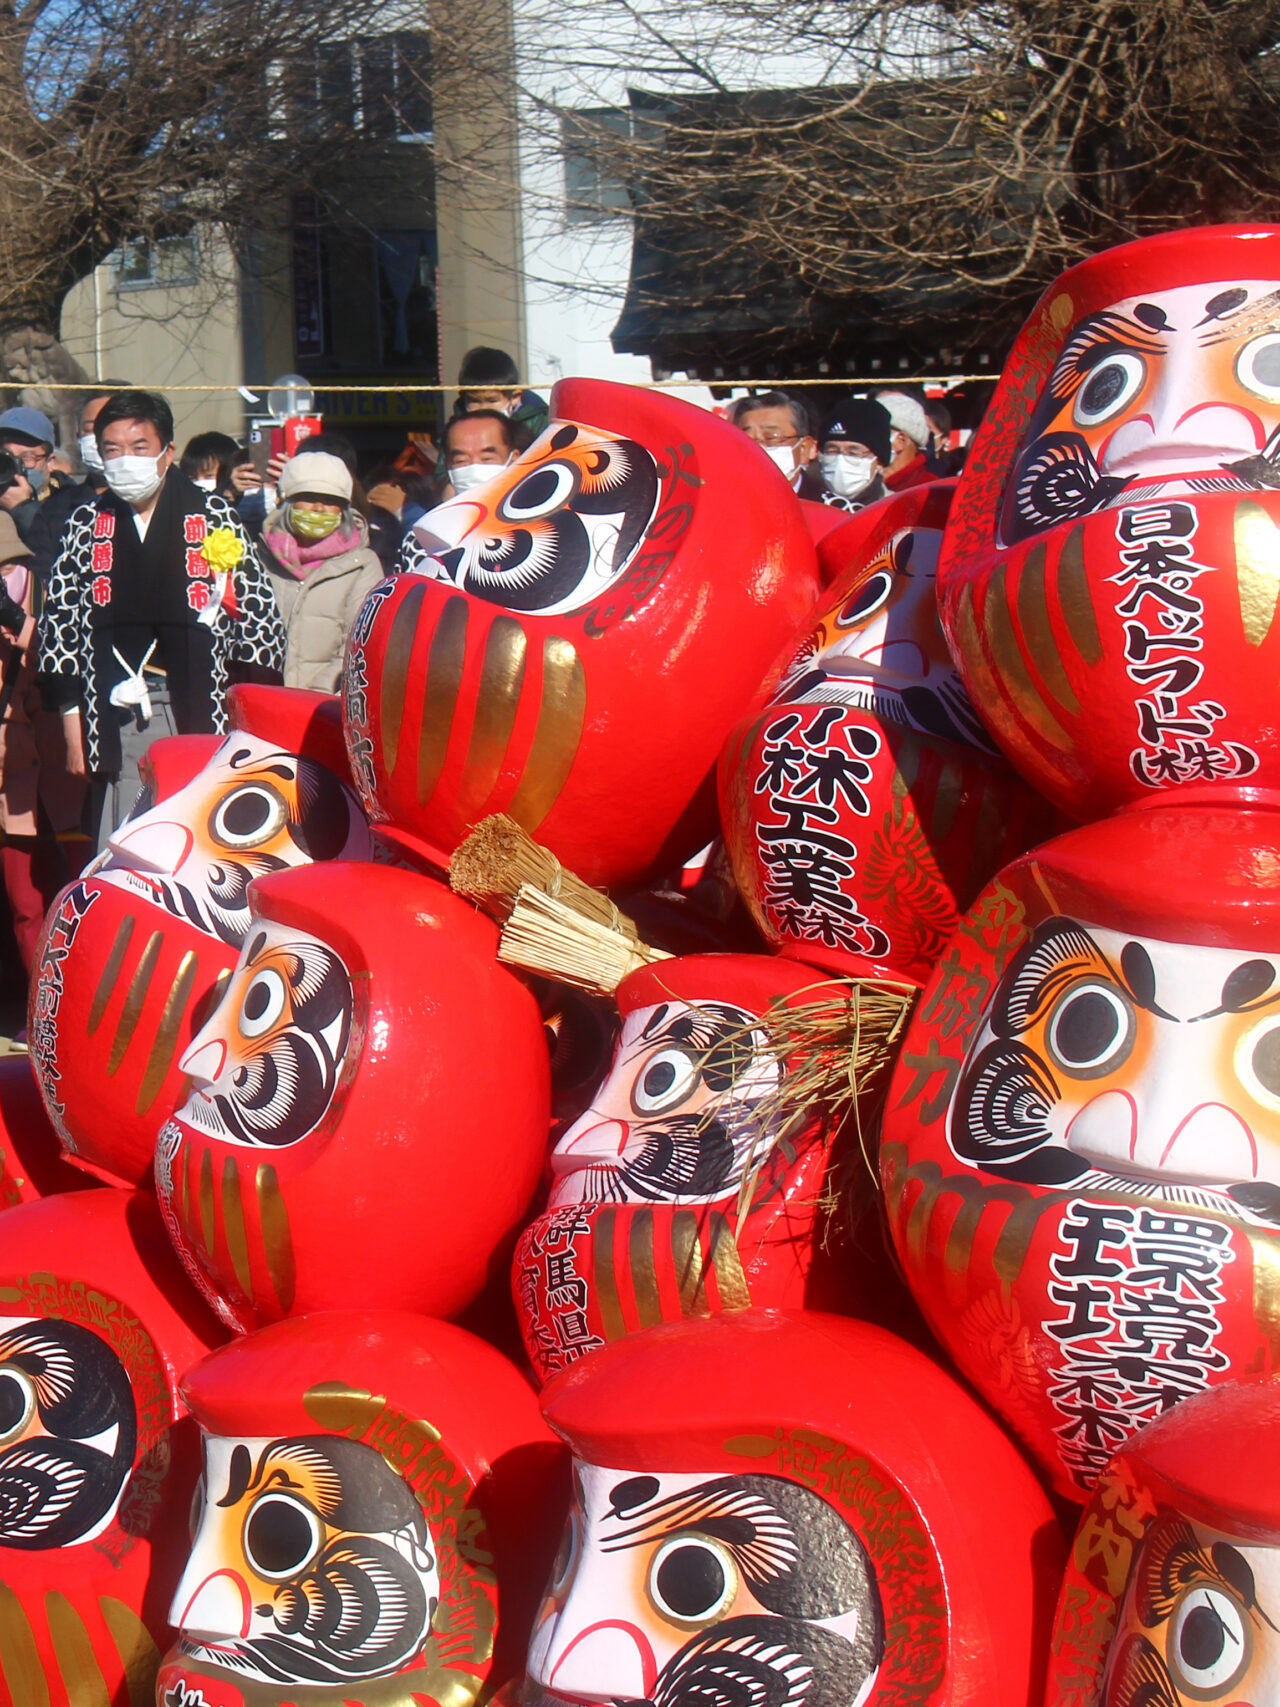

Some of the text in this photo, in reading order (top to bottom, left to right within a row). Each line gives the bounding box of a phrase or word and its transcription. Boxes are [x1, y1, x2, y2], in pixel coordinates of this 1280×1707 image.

[91, 510, 116, 607] 前橋市
[563, 443, 705, 639] 火の用心
[541, 1204, 605, 1365] 群馬県
